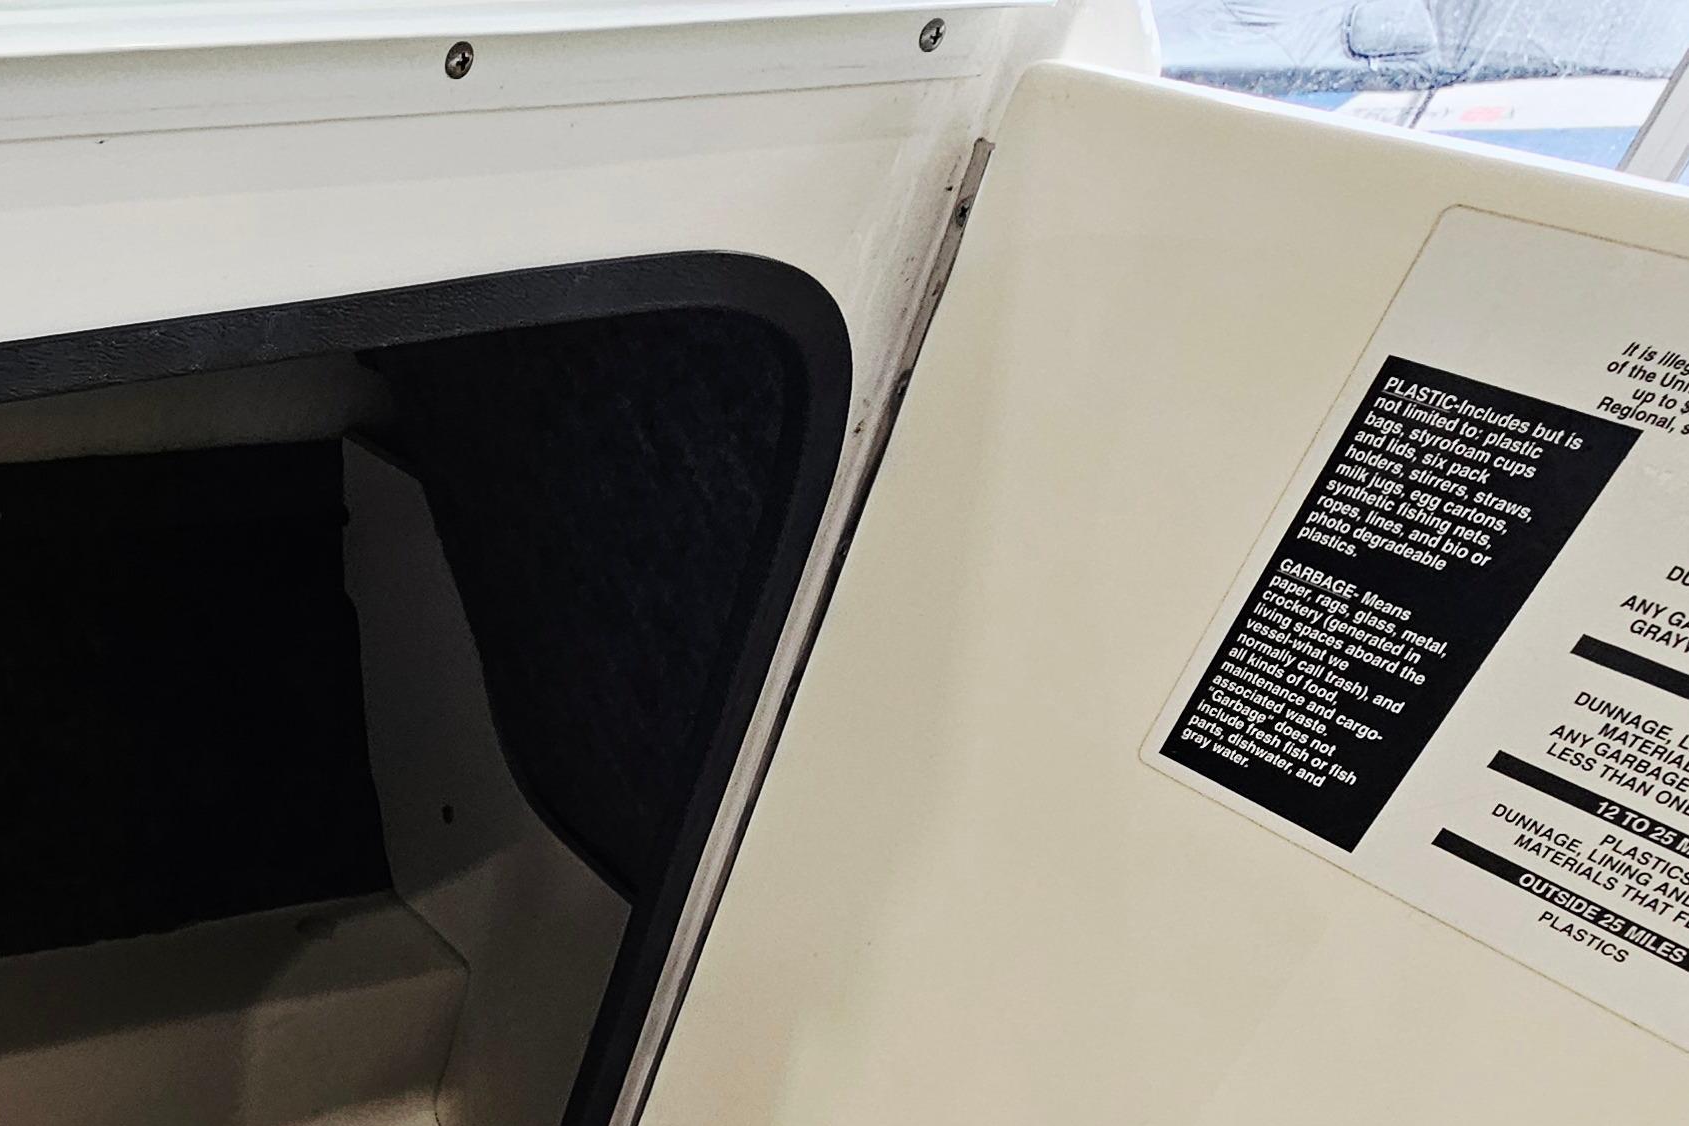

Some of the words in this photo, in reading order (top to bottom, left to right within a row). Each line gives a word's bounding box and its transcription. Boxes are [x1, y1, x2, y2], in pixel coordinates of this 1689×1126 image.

[1607, 360, 1631, 375] of
[1628, 364, 1657, 383] the
[1622, 341, 1641, 357] It
[1638, 345, 1658, 362] is
[1632, 388, 1656, 408] up
[1658, 393, 1677, 410] to
[1363, 409, 1405, 439] bags,
[1408, 428, 1492, 464] styrofoam
[1492, 455, 1537, 479] cups
[1373, 396, 1404, 415] not
[1401, 402, 1461, 433] limited
[1458, 420, 1484, 441] to:
[1481, 431, 1544, 460] plastic
[1530, 421, 1566, 445] but
[1563, 431, 1584, 451] is
[1344, 443, 1405, 479] holders,
[1407, 468, 1469, 501] stirrers,
[1472, 491, 1533, 524] straws,
[1353, 430, 1388, 449] and
[1385, 437, 1423, 463] lids,
[1421, 452, 1449, 471] six
[1445, 461, 1491, 485] pack
[1325, 479, 1396, 514] synthetic
[1395, 501, 1453, 536] fishing
[1451, 524, 1492, 551] nets,
[1334, 463, 1370, 483] milk
[1366, 471, 1406, 499] jugs,
[1409, 489, 1443, 512] egg
[1442, 500, 1508, 536] cartons,
[1296, 520, 1358, 558] plastics.
[1305, 509, 1352, 535] photo
[1352, 525, 1448, 571] degradeable
[1316, 492, 1362, 522] ropes,
[1364, 509, 1405, 538] lines,
[1407, 528, 1444, 549] and
[1440, 537, 1470, 559] bio
[1469, 551, 1493, 567] or
[1261, 584, 1324, 625] crockery
[1322, 609, 1406, 657] (generated
[1403, 646, 1422, 665] in
[1268, 574, 1313, 603] paper,
[1314, 593, 1351, 619] rags,
[1351, 609, 1397, 638] glass,
[1400, 629, 1449, 659] metal,
[1360, 590, 1412, 621] Means
[1619, 595, 1668, 619] ANY
[1548, 724, 1594, 749] ANY
[1573, 691, 1674, 746] DUNNAGE,
[1545, 741, 1598, 772] LESS
[1599, 763, 1656, 797] THAN
[1491, 802, 1584, 858] DUNNAGE,
[1586, 847, 1654, 887] LINING
[1596, 801, 1621, 821] 12
[1621, 810, 1651, 833] TO
[1648, 825, 1678, 846] 25
[1513, 833, 1619, 891] MATERIALS
[1621, 883, 1675, 915] THAT
[1515, 872, 1602, 921] OUTSIDE
[1597, 913, 1626, 933] 25
[1623, 925, 1689, 963] MILES
[1537, 910, 1630, 963] PLASTICS
